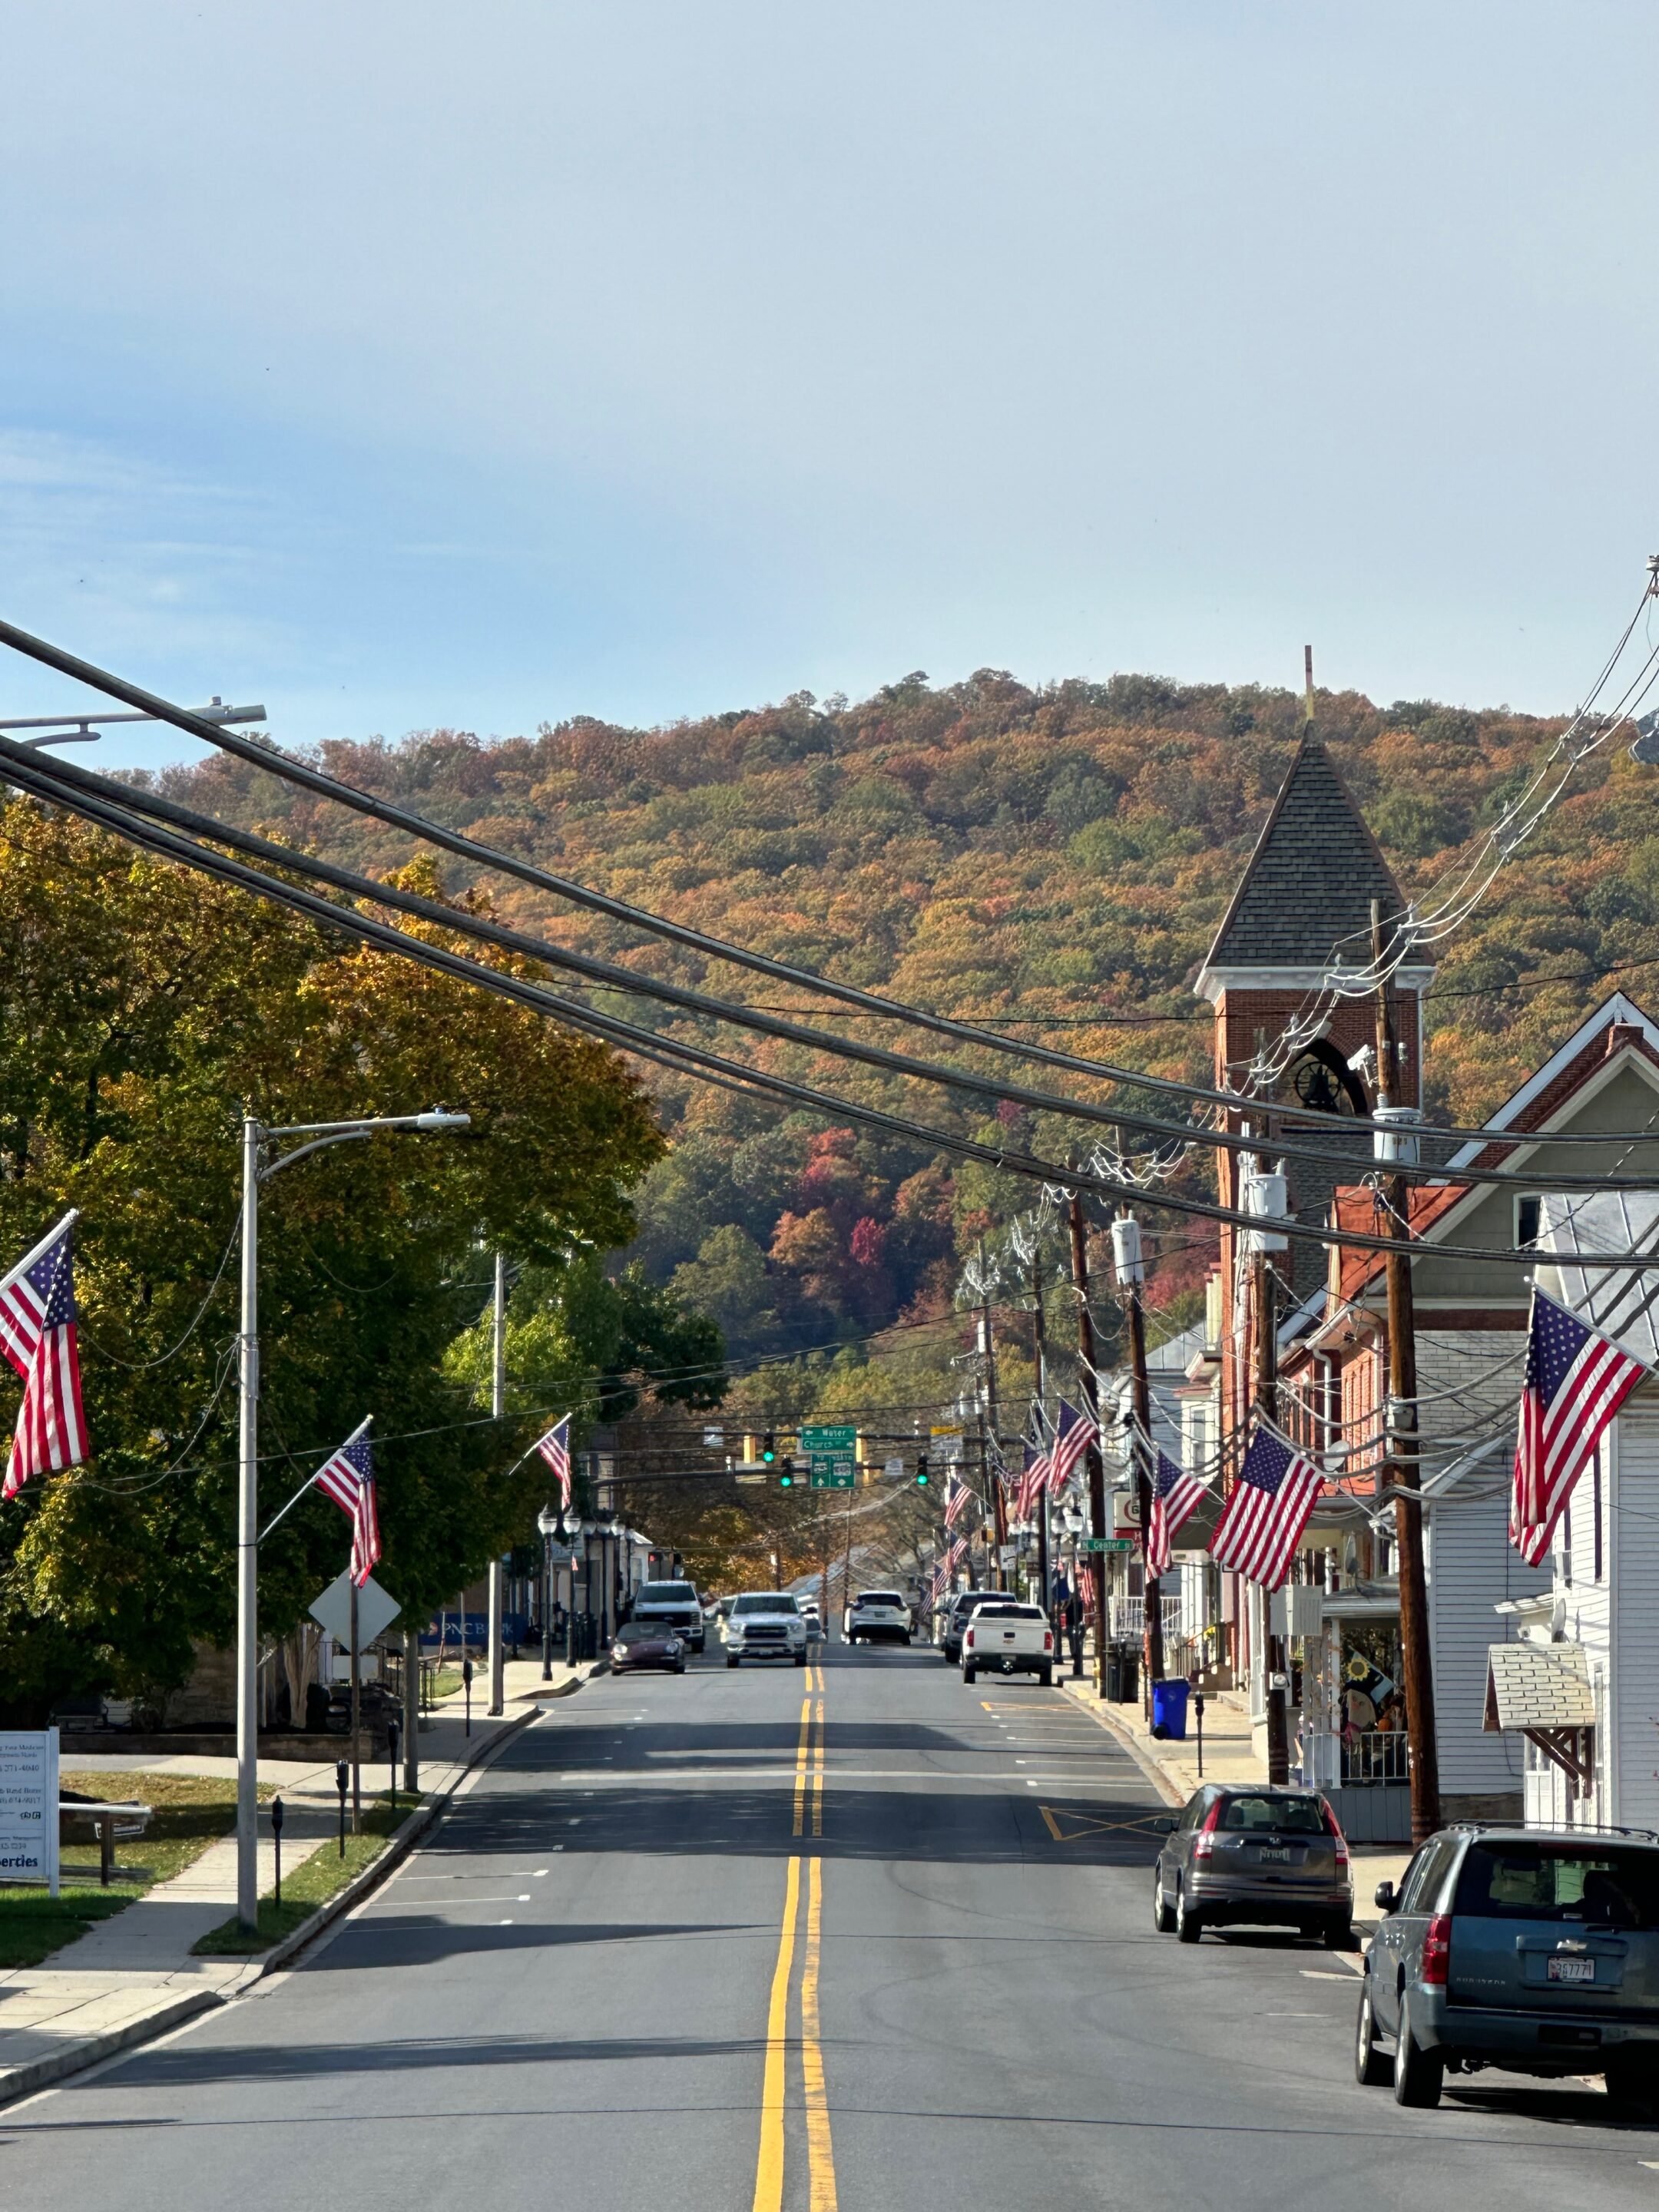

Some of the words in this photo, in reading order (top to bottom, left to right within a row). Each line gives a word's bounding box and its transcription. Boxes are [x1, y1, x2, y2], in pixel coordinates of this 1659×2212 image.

[1094, 1540, 1120, 1550] Center
[442, 1622, 473, 1635] PNC
[475, 1622, 514, 1635] BNK
[0, 1854, 38, 1867] erties
